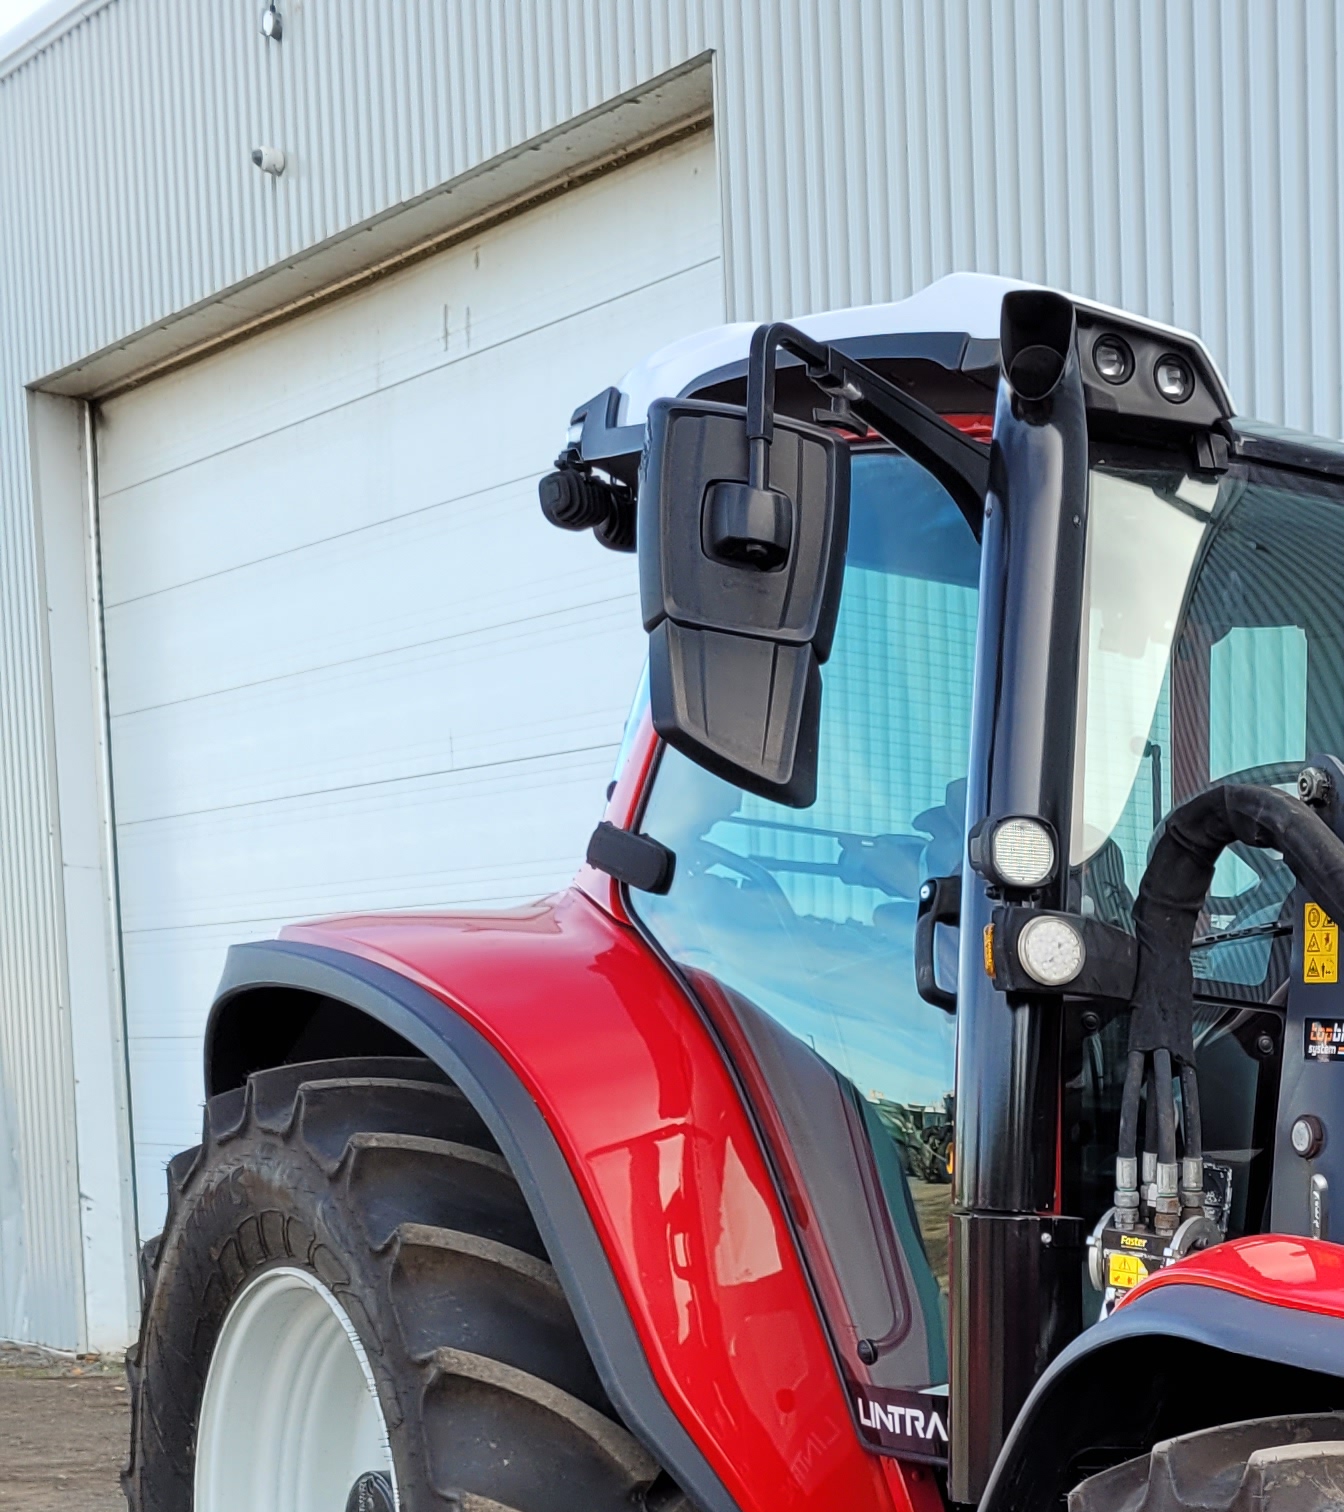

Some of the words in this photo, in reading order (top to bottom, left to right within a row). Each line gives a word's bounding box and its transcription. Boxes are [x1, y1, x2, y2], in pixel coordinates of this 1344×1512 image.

[1308, 1043, 1337, 1056] system
[1120, 1234, 1148, 1248] Faster
[857, 1396, 949, 1442] LINTRA
